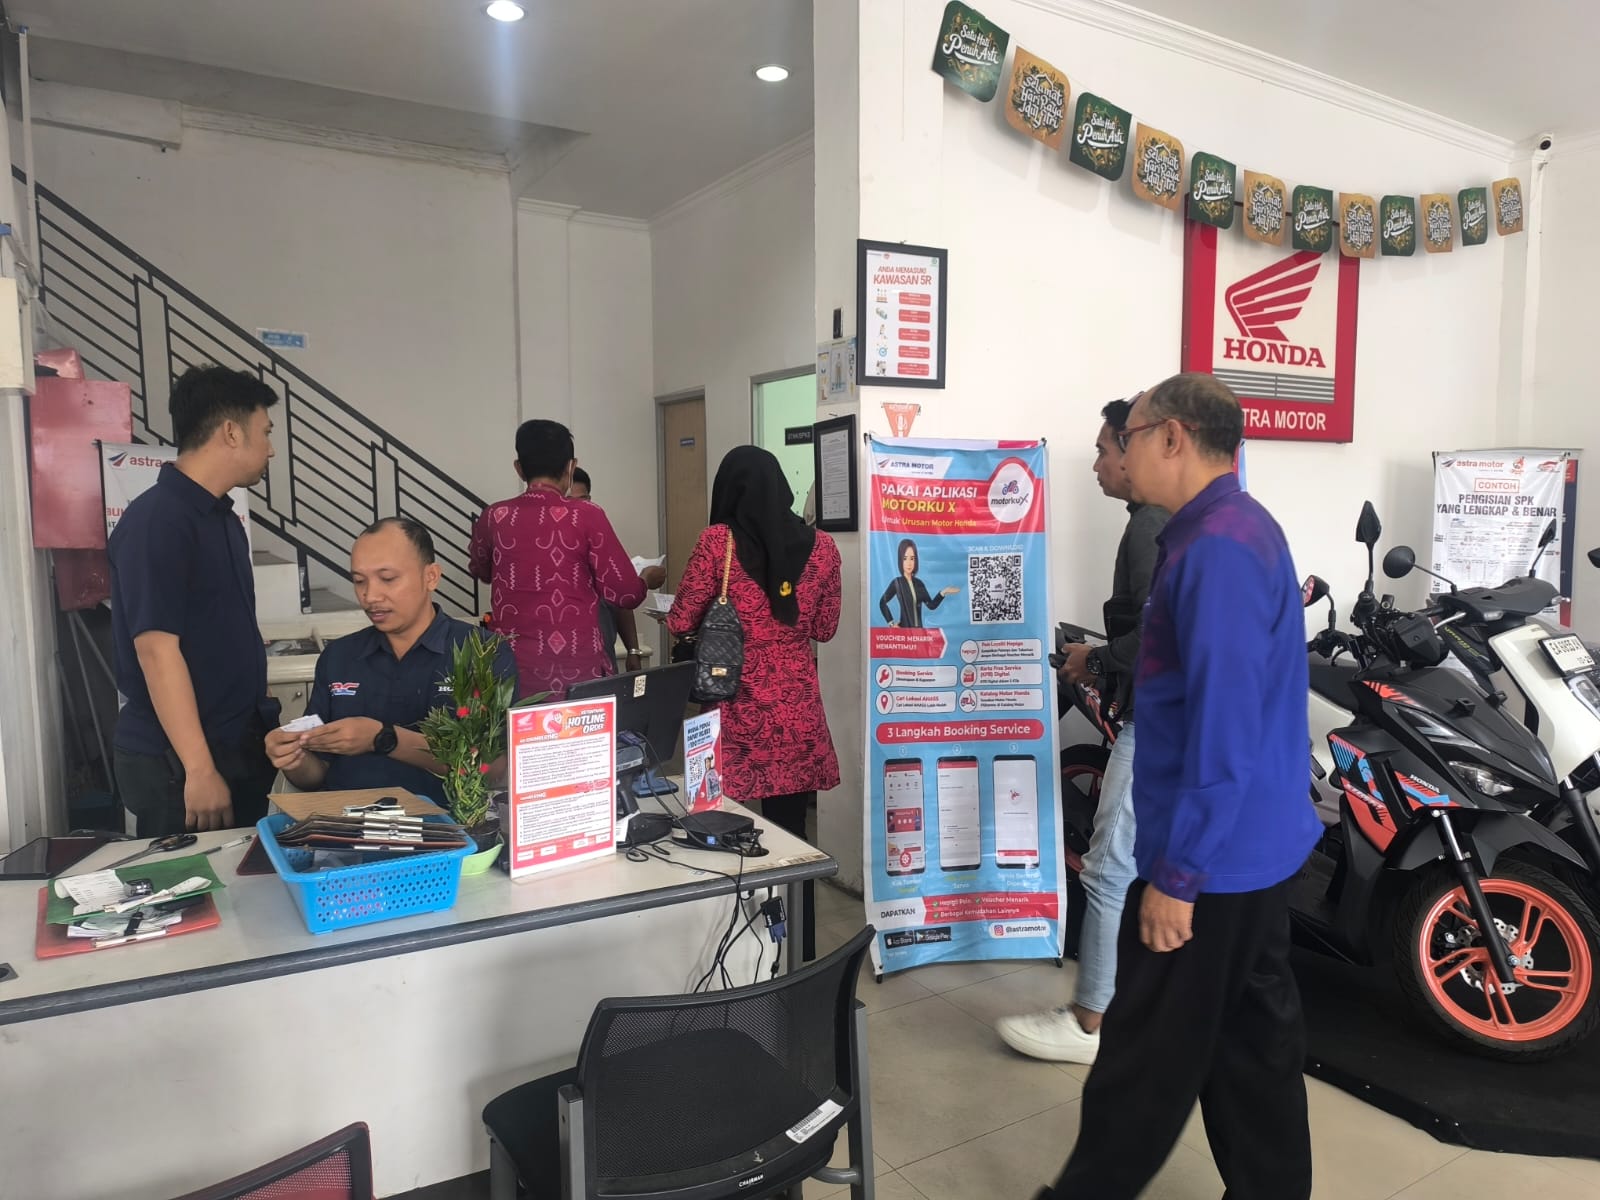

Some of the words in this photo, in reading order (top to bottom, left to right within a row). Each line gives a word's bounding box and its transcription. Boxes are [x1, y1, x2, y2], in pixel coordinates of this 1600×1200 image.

[960, 24, 977, 42] Satu
[942, 33, 981, 60] Penuh
[979, 45, 999, 64] Arti
[1023, 75, 1063, 105] Selamat
[1020, 85, 1040, 105] Hari
[1040, 94, 1063, 118] Raya
[1091, 113, 1105, 126] Satu
[1077, 123, 1107, 144] Penuh
[1106, 130, 1124, 144] Arti
[873, 274, 919, 285] KAWASAN
[920, 274, 932, 285] 5R
[1223, 337, 1326, 369] HONDA
[1242, 408, 1271, 428] TRA
[1274, 410, 1326, 431] MOTOR
[130, 455, 162, 467] astra
[911, 462, 934, 470] MOTOR
[1456, 460, 1478, 468] astra
[1479, 460, 1504, 468] motor
[881, 482, 919, 497] PAKAI
[922, 486, 978, 499] APLIKASI
[1478, 481, 1517, 490] CONTOH
[882, 497, 945, 513] MOTORKU
[947, 501, 956, 513] X
[1458, 493, 1511, 505] PENGISIAN
[1514, 495, 1534, 506] SPK
[1436, 504, 1461, 515] YANG
[1463, 504, 1508, 516] LENGKAP
[1512, 506, 1520, 516] &
[1523, 507, 1557, 517] BENAR
[902, 517, 930, 526] Urusan
[931, 518, 953, 527] Motor
[954, 519, 977, 527] Honda
[567, 712, 607, 728] HOTLINE
[582, 723, 604, 734] ORDER
[887, 727, 894, 737] 3
[895, 726, 941, 739] Langkah
[944, 724, 987, 738] Booking
[990, 723, 1031, 735] Service
[1409, 774, 1440, 793] HONDA
[880, 907, 916, 918] DAPATKAN
[940, 910, 963, 918] Berbagai
[738, 1173, 764, 1187] CHAIRMAN
